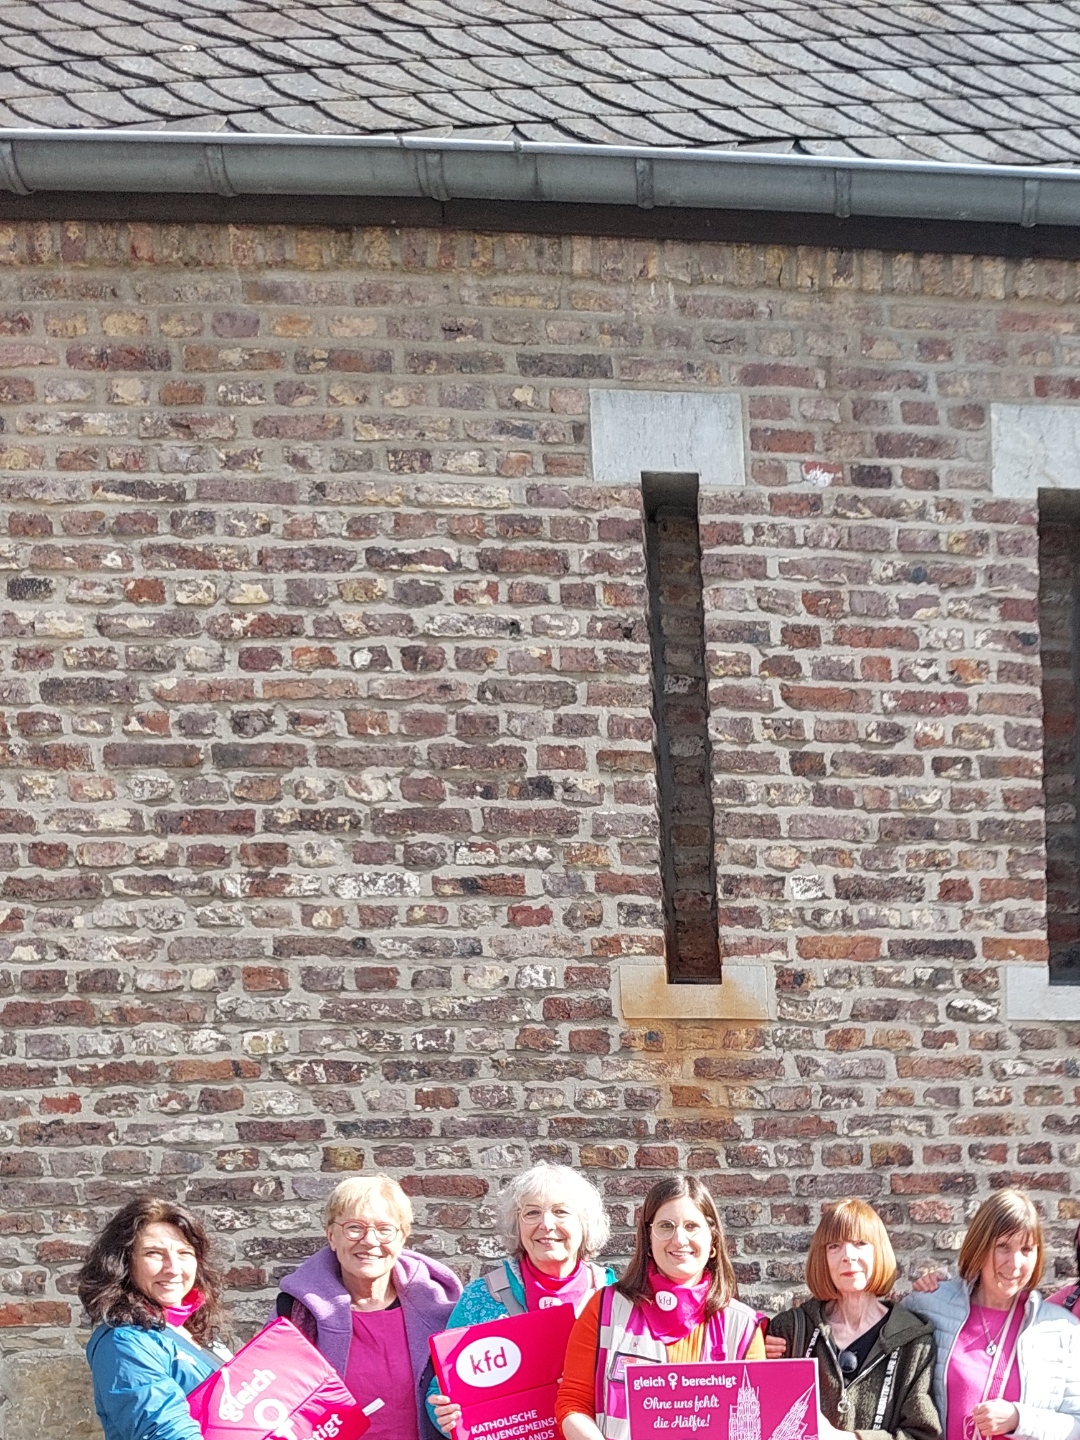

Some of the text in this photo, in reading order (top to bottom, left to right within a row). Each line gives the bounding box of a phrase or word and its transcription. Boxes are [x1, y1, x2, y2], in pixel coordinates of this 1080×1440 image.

[658, 1295, 672, 1306] kfd
[469, 1346, 508, 1375] kfd
[633, 1374, 738, 1391] gleich berechtigt
[218, 1368, 277, 1422] gleich
[643, 1394, 720, 1412] Ohne uns fehlt
[470, 1409, 538, 1435] KATHOLISCHE
[653, 1414, 711, 1431] die Hälfte!
